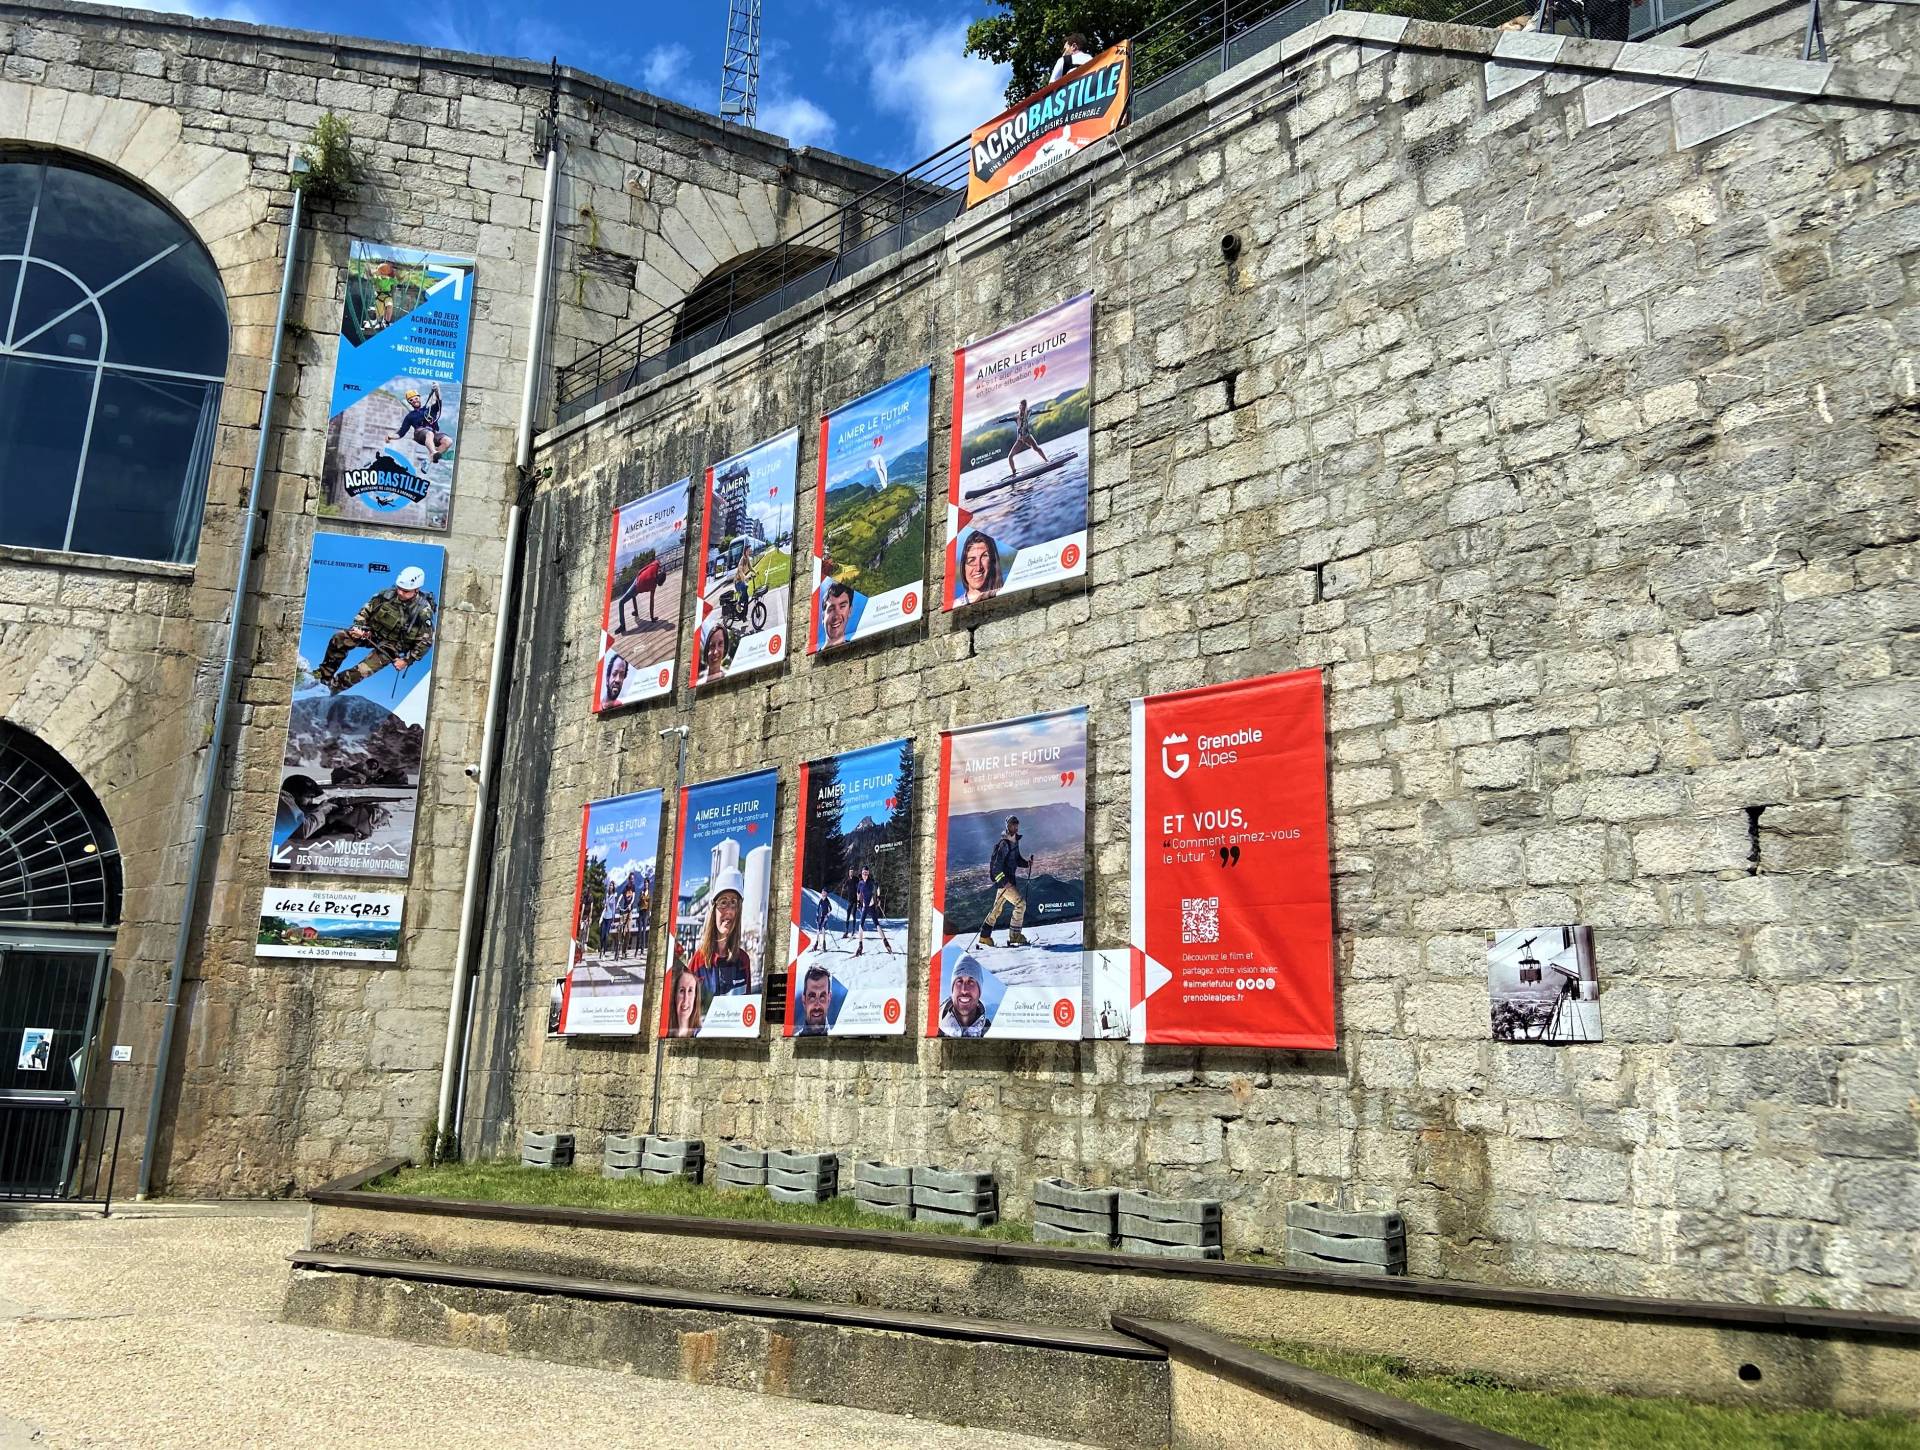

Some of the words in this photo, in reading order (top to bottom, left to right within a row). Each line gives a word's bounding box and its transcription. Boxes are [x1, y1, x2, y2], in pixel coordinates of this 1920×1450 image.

[975, 65, 1122, 172] ACROBASTILLE
[989, 163, 1001, 174] UNE
[1003, 137, 1030, 165] MONTAGNE
[1032, 130, 1040, 138] DE
[1041, 119, 1063, 134] LOISIRS
[1070, 107, 1101, 121] GRENOBLE
[411, 316, 459, 329] ACROBATIQUES
[443, 312, 459, 321] JEUX
[410, 336, 426, 345] TYRO
[424, 328, 457, 338] PARCOURS
[397, 344, 424, 355] MISSION
[425, 347, 455, 359] BASTILLE
[977, 357, 1010, 380] AIMER
[1014, 349, 1027, 364] LE
[1031, 333, 1067, 357] FUTUR
[408, 366, 433, 377] ESCAPE
[435, 368, 453, 380] GAME
[838, 423, 865, 445] AIMER
[868, 416, 878, 430] LE
[881, 401, 910, 424] FUTUR
[345, 470, 429, 496] ACROBASTILLE
[720, 477, 743, 495] AIMER
[756, 459, 782, 478] FUTUR
[625, 519, 644, 535] AIMER
[645, 515, 653, 526] LE
[654, 505, 676, 522] FUTUR
[368, 562, 391, 573] PETZL
[1197, 727, 1263, 751] Grenoble
[965, 756, 999, 773] AIMER
[1004, 753, 1017, 767] LE
[1022, 747, 1060, 764] FUTUR
[1198, 750, 1238, 768] Alpes
[1032, 774, 1059, 784] innover
[818, 783, 846, 800] AIMER
[850, 780, 860, 793] LE
[863, 774, 894, 790] FUTUR
[694, 807, 719, 822] AIMER
[721, 805, 731, 817] LE
[733, 800, 759, 815] FUTUR
[744, 812, 769, 821] construire
[595, 823, 614, 834] AIMER
[616, 821, 624, 832] LE
[625, 817, 647, 830] FUTUR
[1163, 814, 1184, 834] ET
[1193, 808, 1248, 831] VOUS,
[1229, 829, 1301, 844] aimez-vous
[296, 855, 312, 865] DES
[314, 857, 349, 868] TROUPES
[350, 858, 360, 868] DE
[362, 859, 404, 870] MONTAGNE
[1163, 852, 1173, 864] le
[1177, 850, 1205, 863] futur
[275, 900, 303, 912] chez
[308, 901, 320, 913] le
[1183, 953, 1218, 961] Découvrez
[1220, 952, 1227, 960] le
[1229, 952, 1244, 960] film
[1245, 952, 1253, 960] et
[1182, 967, 1213, 976] partagez
[1237, 966, 1258, 974] vision
[1259, 966, 1278, 974] avec
[1183, 980, 1234, 988] #aimerlefutur
[1183, 993, 1244, 1003] grenoblealpes.fr
